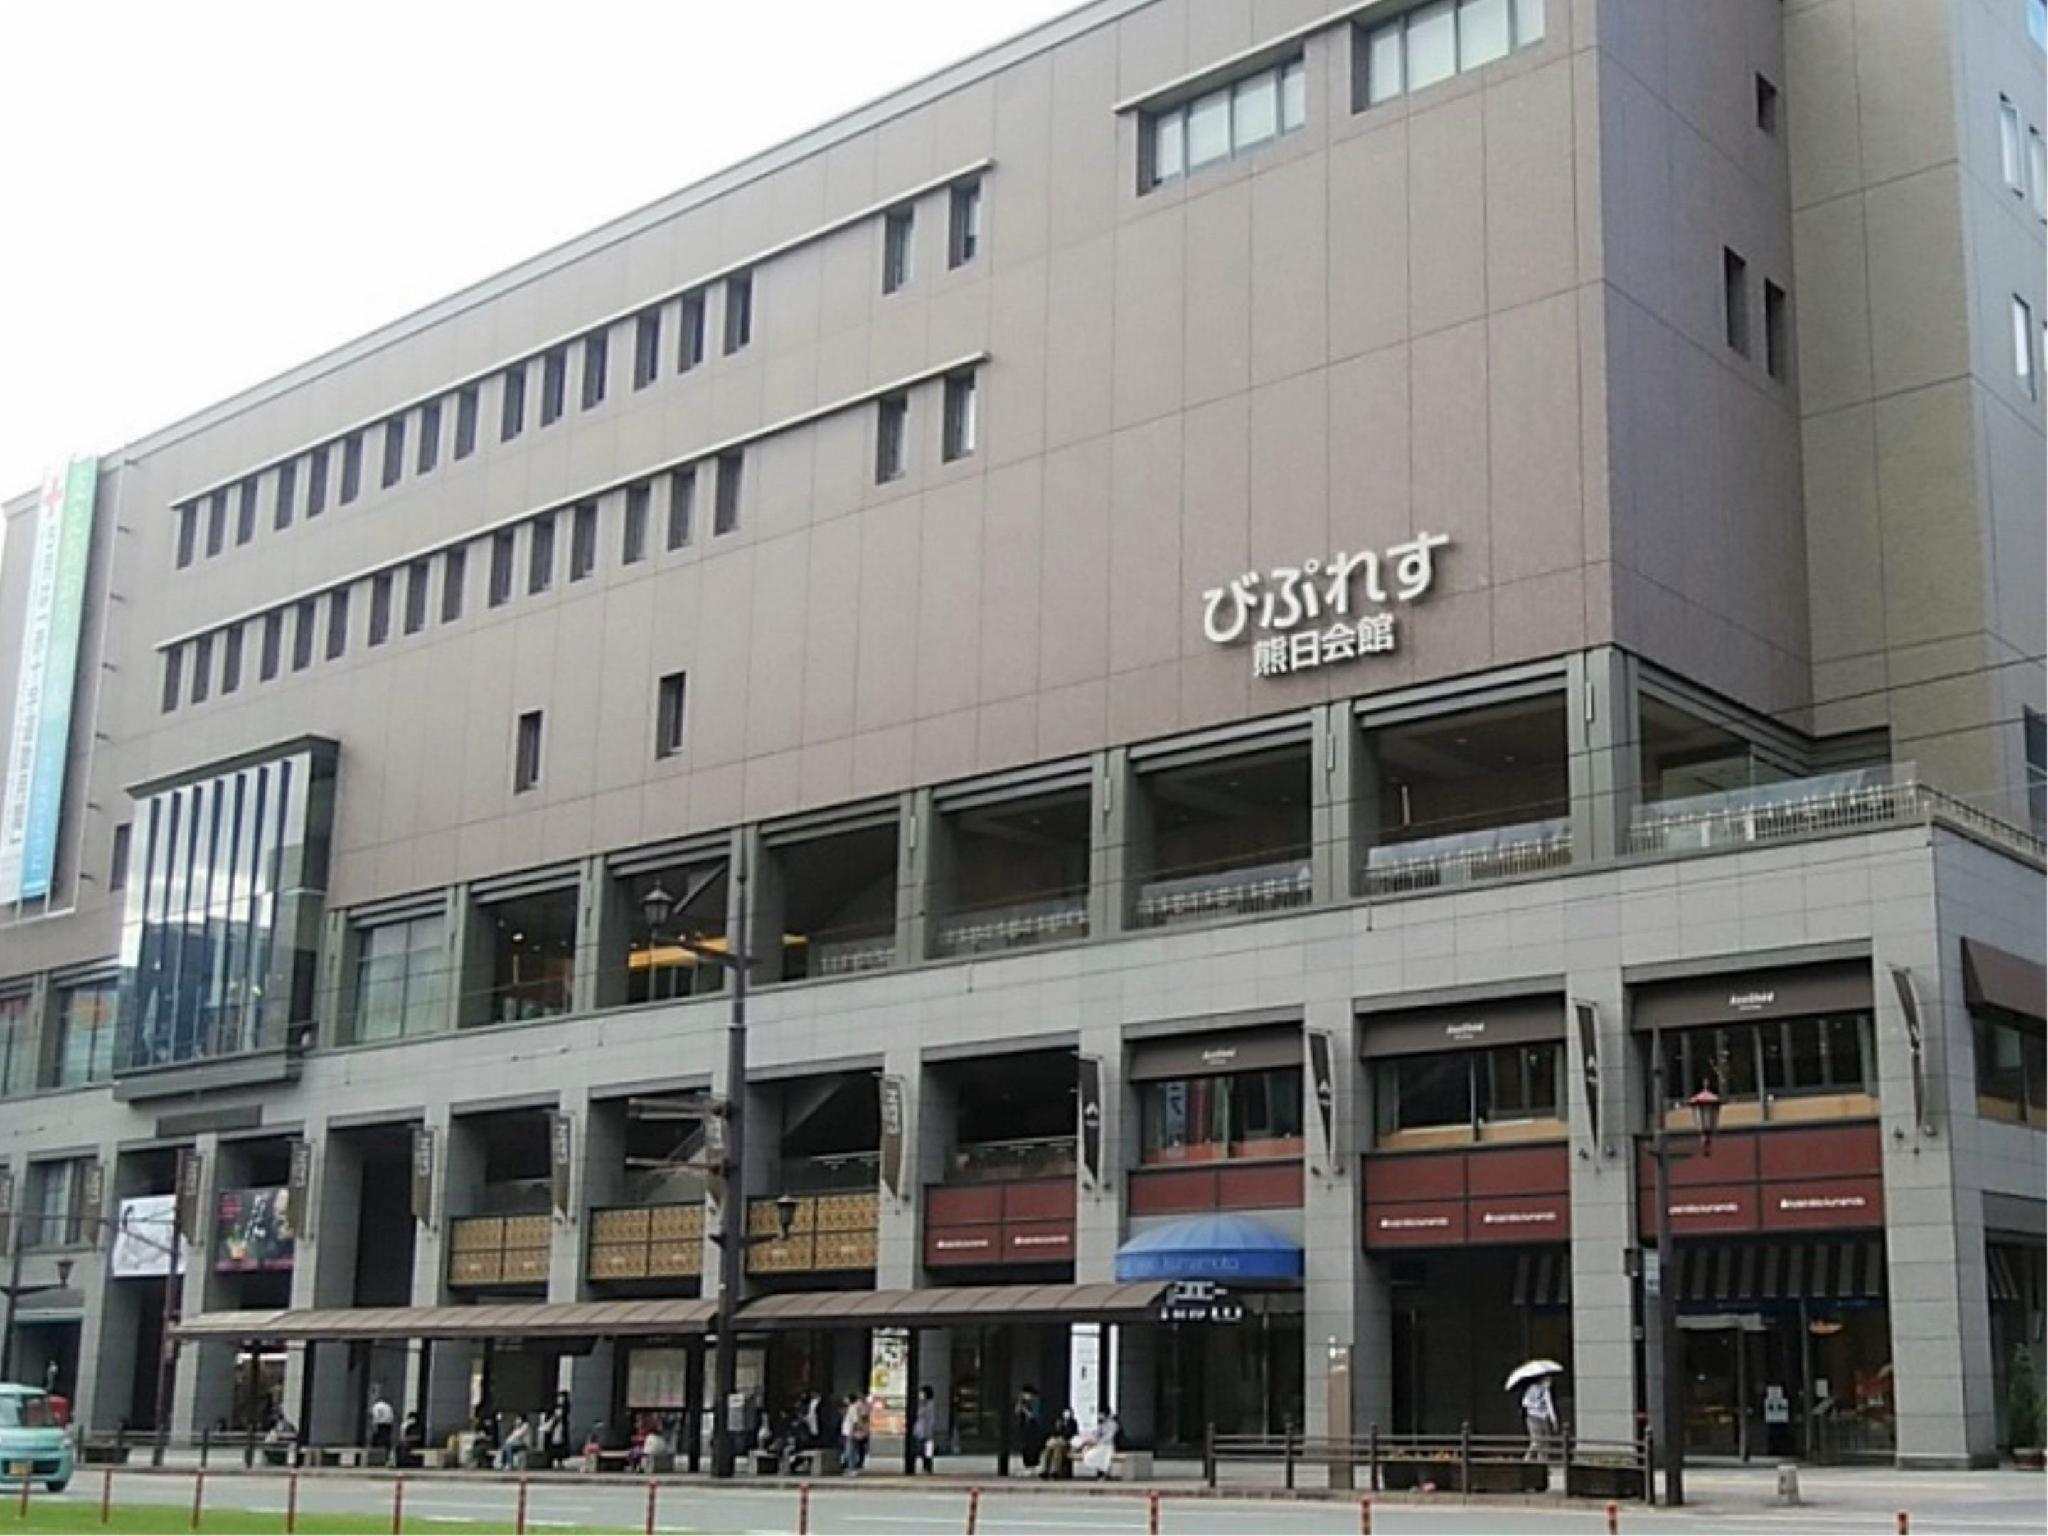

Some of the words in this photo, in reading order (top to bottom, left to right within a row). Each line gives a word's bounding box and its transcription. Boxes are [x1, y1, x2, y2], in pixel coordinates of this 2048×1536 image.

[1203, 531, 1449, 642] びぷれす
[1253, 612, 1394, 676] 熊日会館
